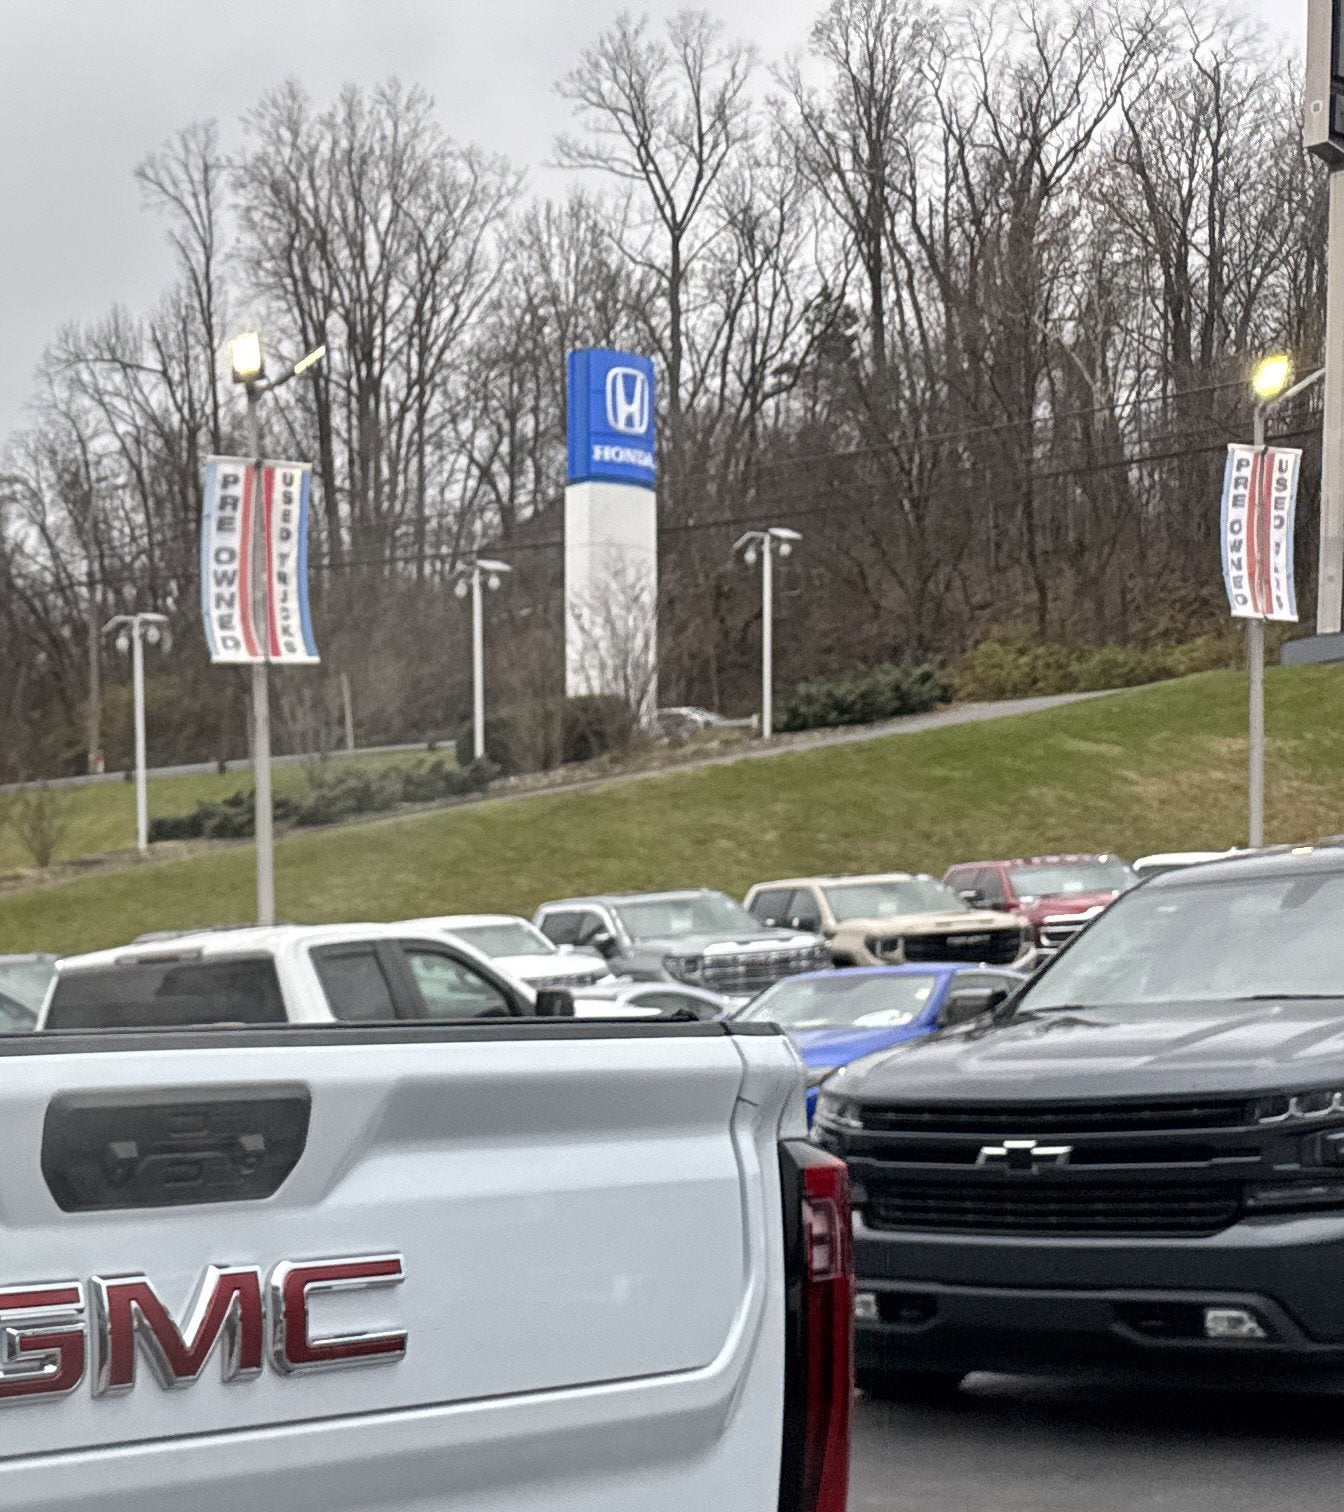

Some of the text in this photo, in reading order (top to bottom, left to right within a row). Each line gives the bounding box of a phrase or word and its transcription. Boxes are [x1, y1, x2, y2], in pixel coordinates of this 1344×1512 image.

[280, 472, 295, 541] USED
[1273, 458, 1289, 530] USED
[213, 547, 241, 652] OWNED
